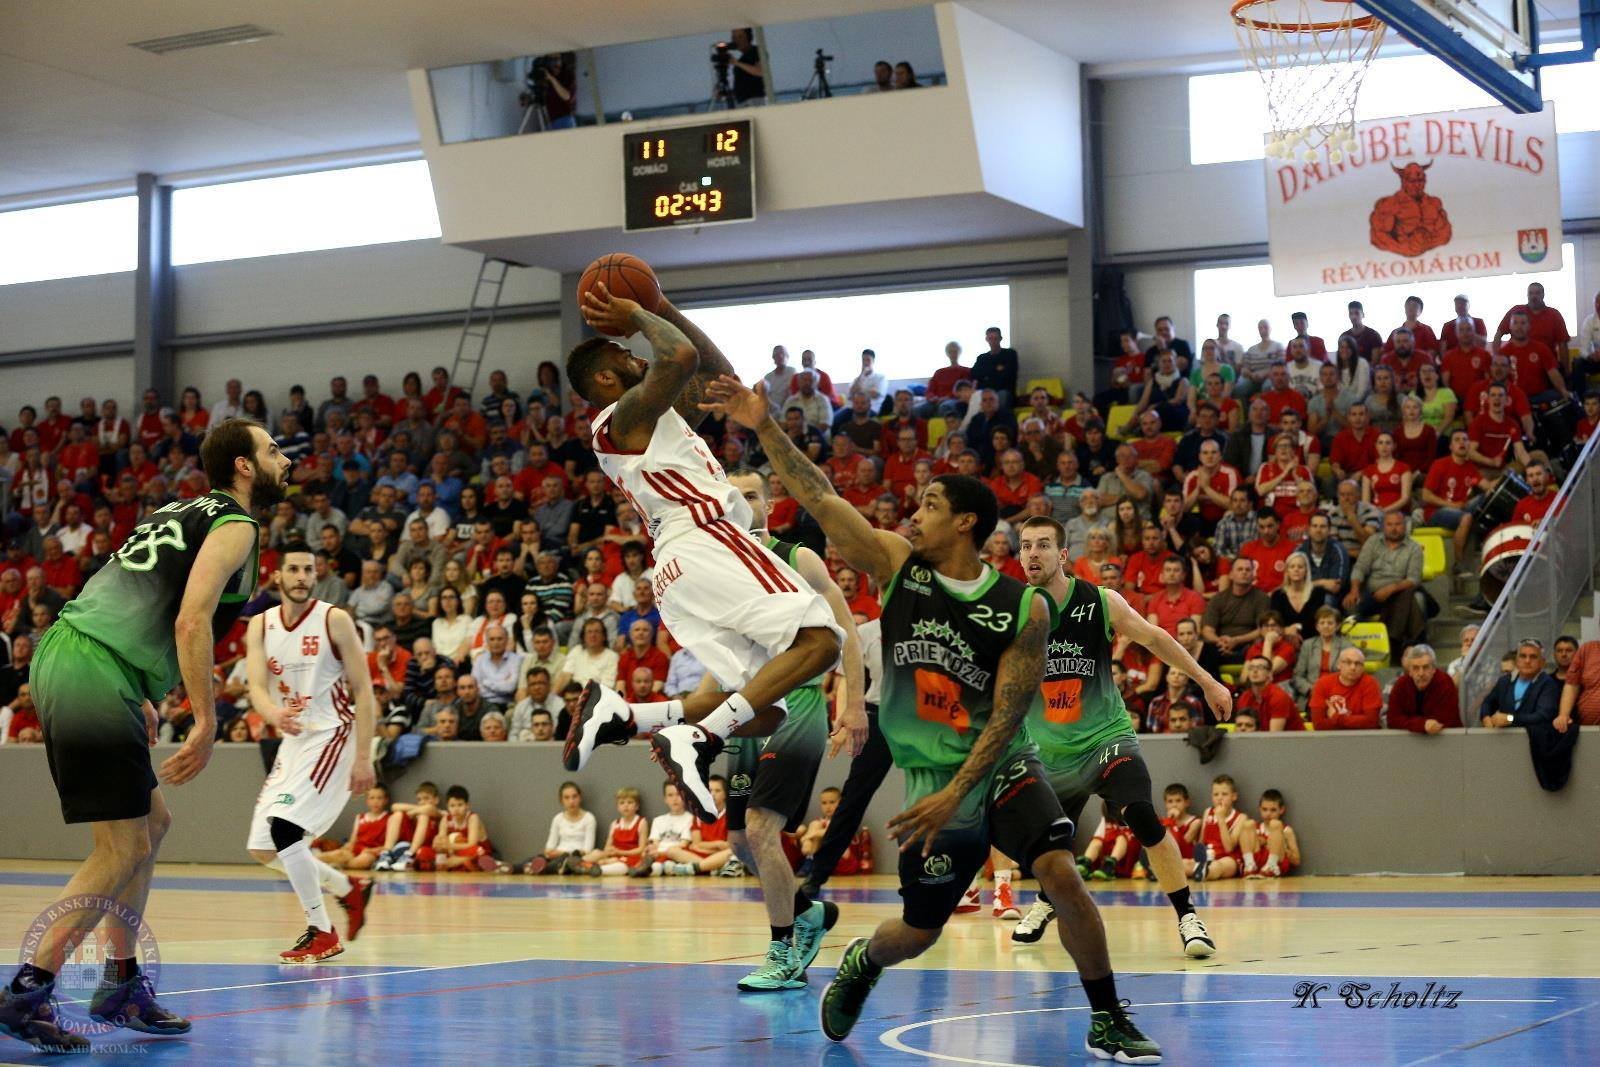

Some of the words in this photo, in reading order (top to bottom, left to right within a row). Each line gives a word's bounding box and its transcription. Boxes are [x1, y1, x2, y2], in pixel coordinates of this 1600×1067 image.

[643, 139, 666, 159] 11
[716, 129, 739, 152] 12
[1424, 119, 1544, 175] DEVILS
[655, 190, 722, 217] 02:43
[1321, 251, 1502, 285] RÉVKOMÁROM
[967, 604, 1013, 632] 23
[302, 635, 320, 656] 55
[993, 760, 1028, 801] 23
